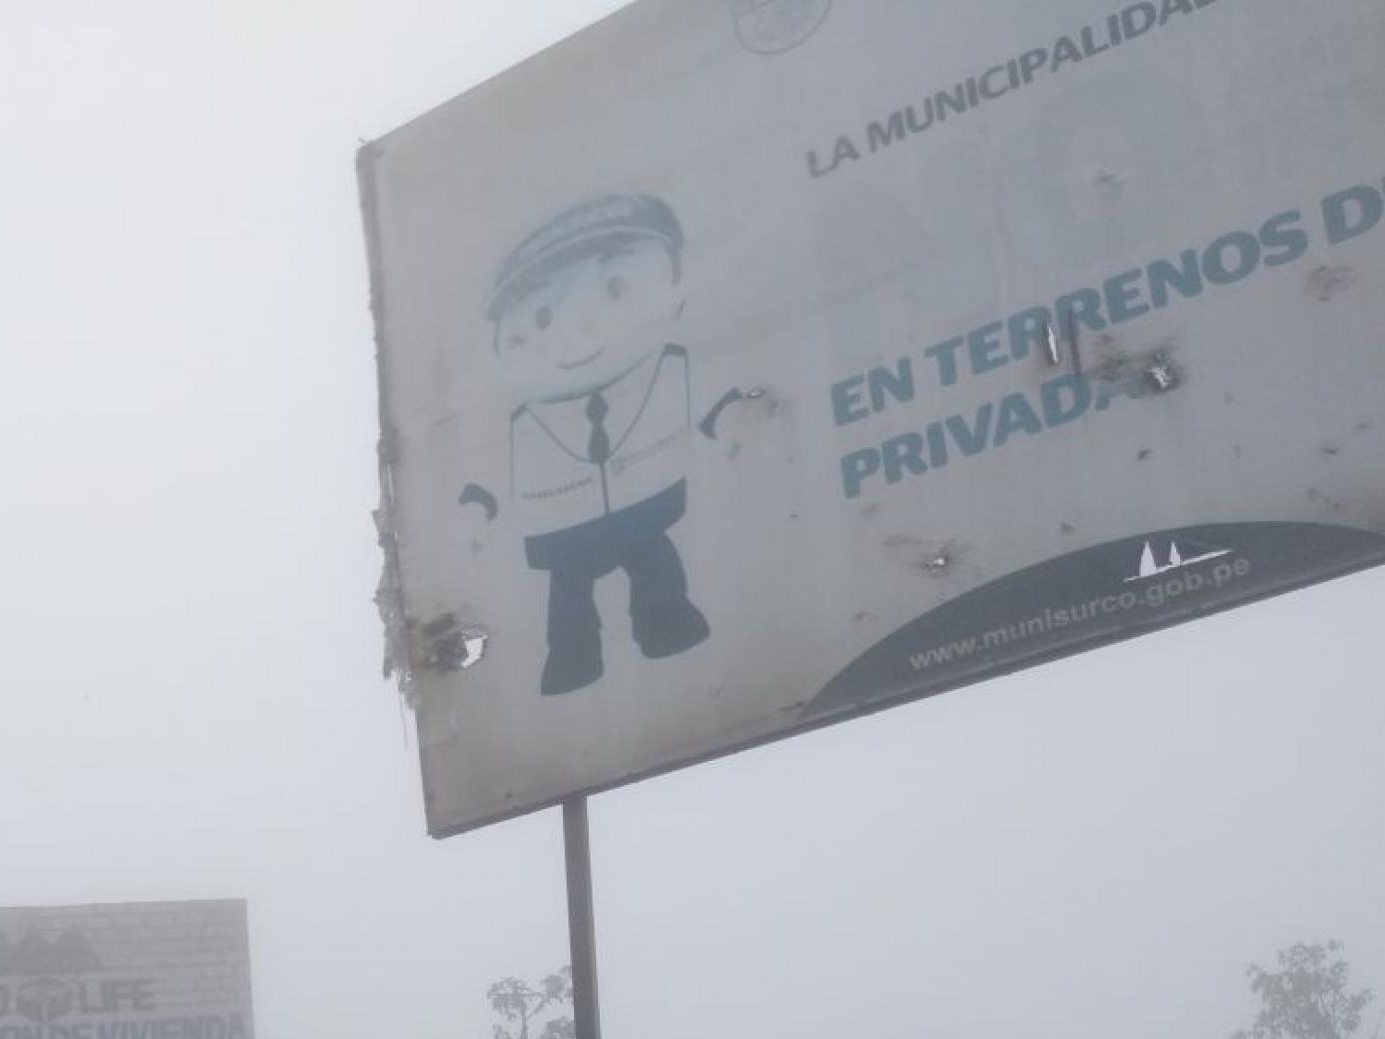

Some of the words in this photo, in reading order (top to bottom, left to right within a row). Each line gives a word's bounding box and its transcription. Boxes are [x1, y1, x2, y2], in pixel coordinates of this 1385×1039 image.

[806, 135, 860, 178] LA
[830, 357, 912, 427] EN
[925, 209, 1309, 376] TERRENOS
[1319, 176, 1385, 245] D
[909, 554, 1252, 671] www.munisurco.gob.pe
[79, 978, 156, 1014] LIFE
